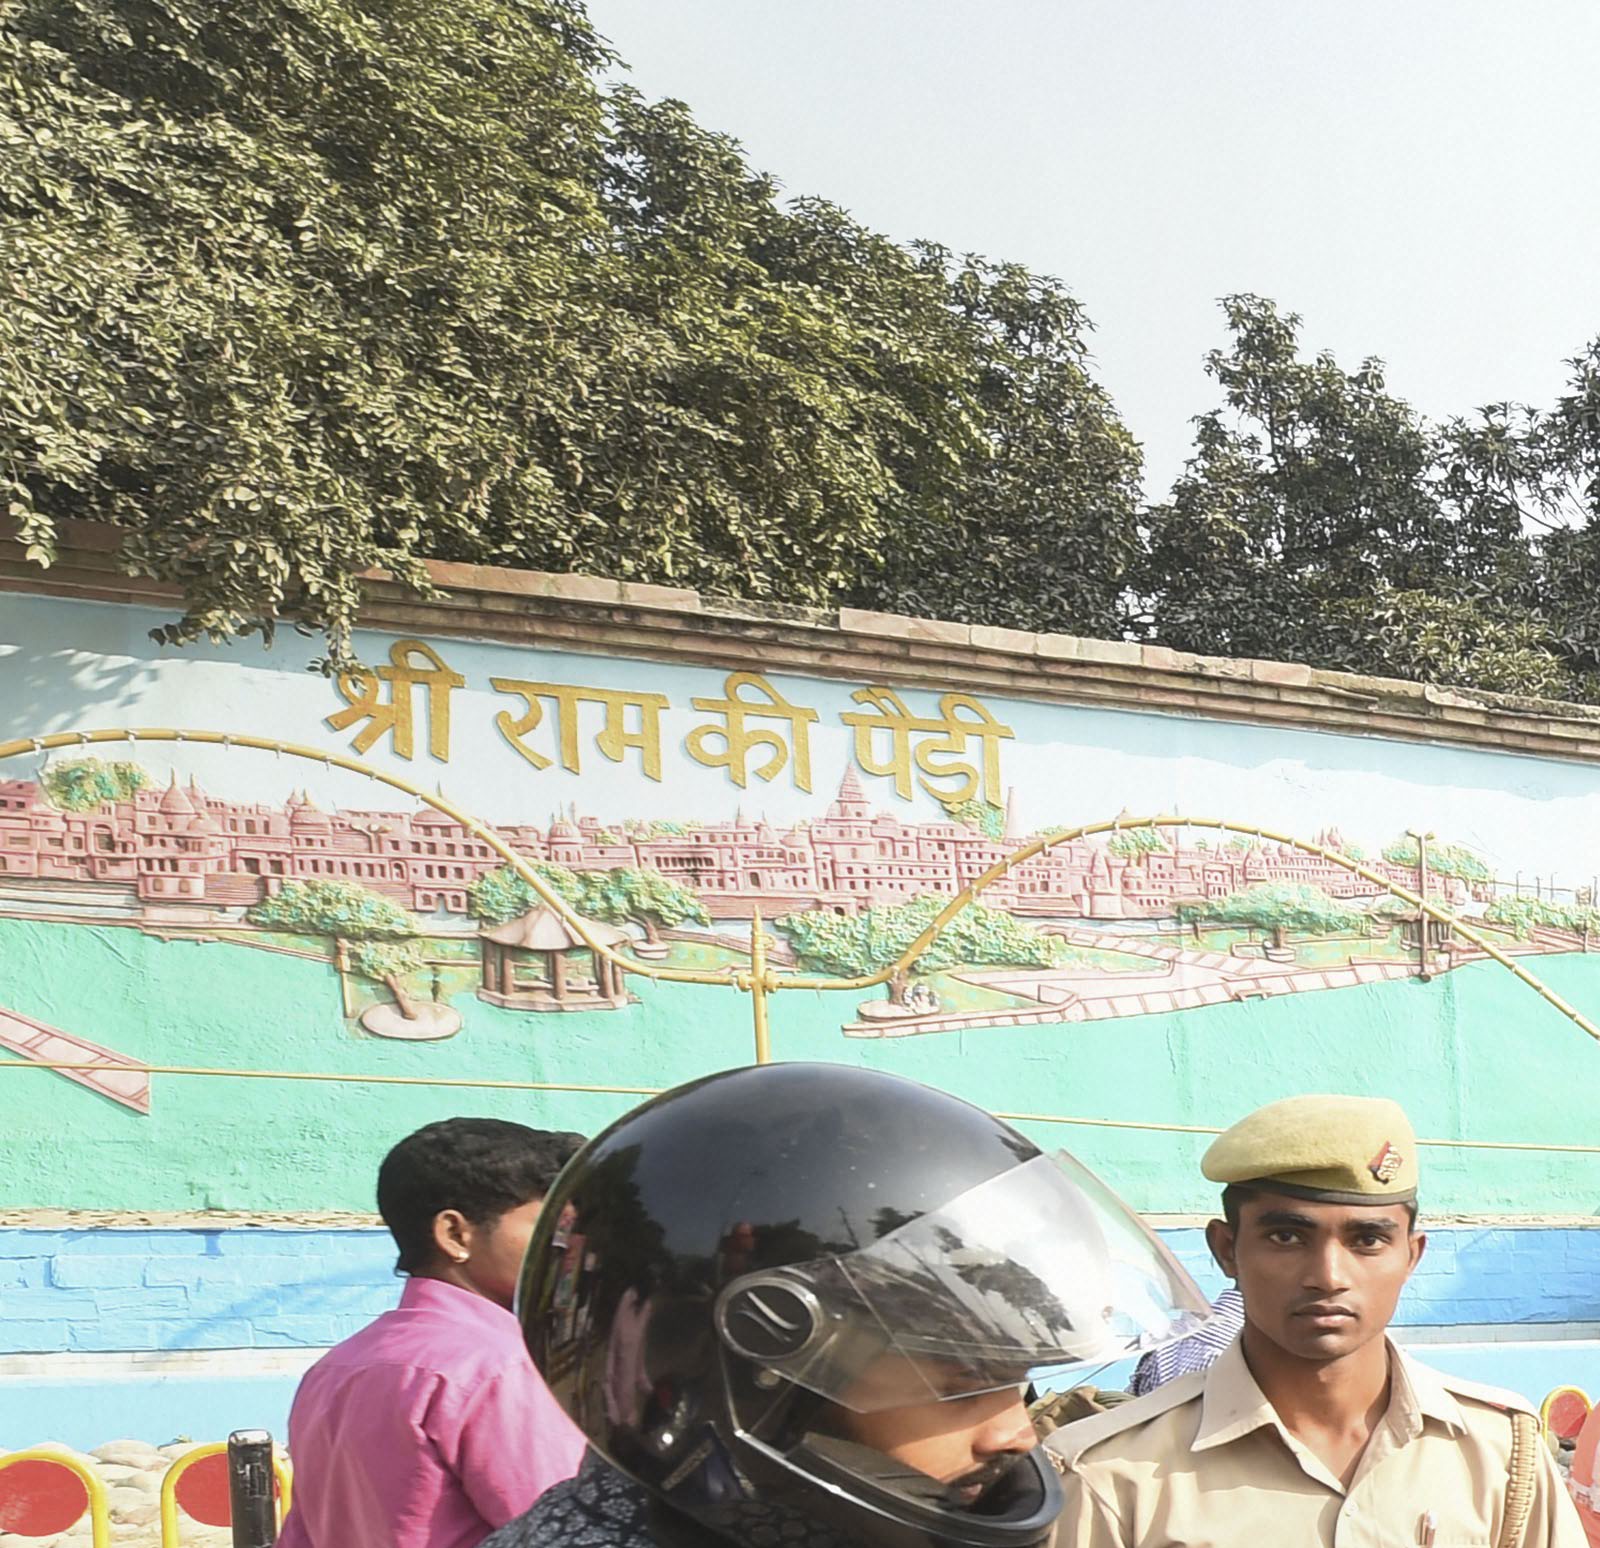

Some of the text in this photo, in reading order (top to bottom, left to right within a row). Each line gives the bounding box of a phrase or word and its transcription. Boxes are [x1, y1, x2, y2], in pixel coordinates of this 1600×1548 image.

[325, 639, 466, 763] श्री
[489, 675, 670, 783] राम
[684, 671, 820, 794] की
